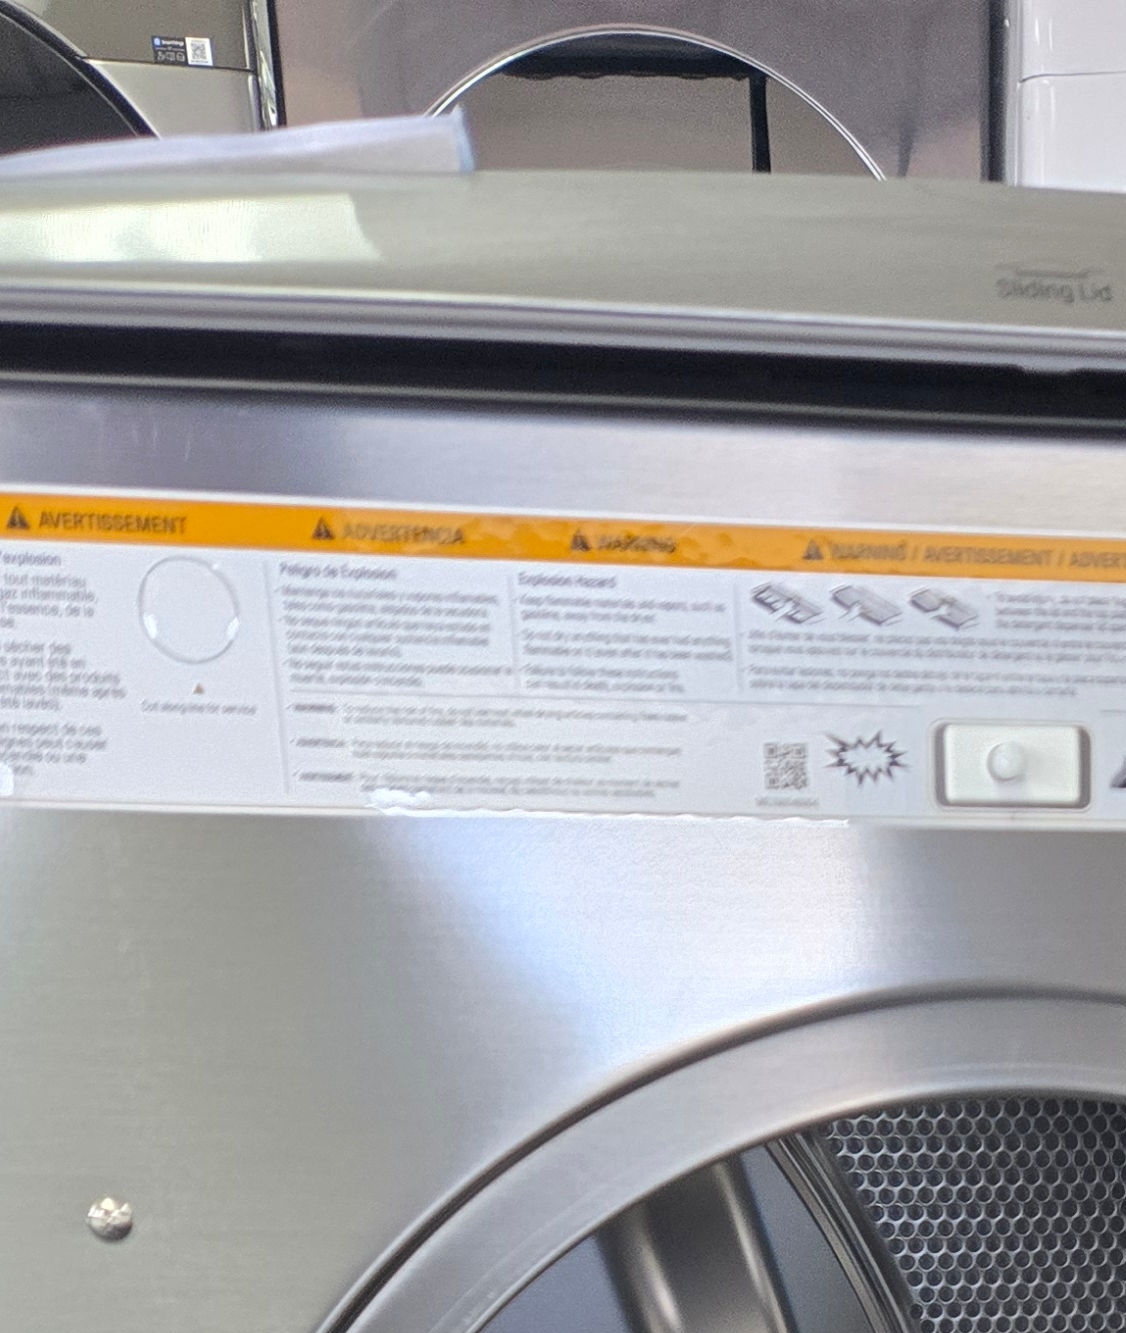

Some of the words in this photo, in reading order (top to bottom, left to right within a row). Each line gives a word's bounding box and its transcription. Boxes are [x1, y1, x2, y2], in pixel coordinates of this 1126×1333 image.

[39, 511, 187, 535] AVERTISSEMENT
[343, 523, 465, 545] ADVERTENCIA
[831, 543, 905, 561] WARNING
[924, 546, 1052, 567] AVERTISSEMENT
